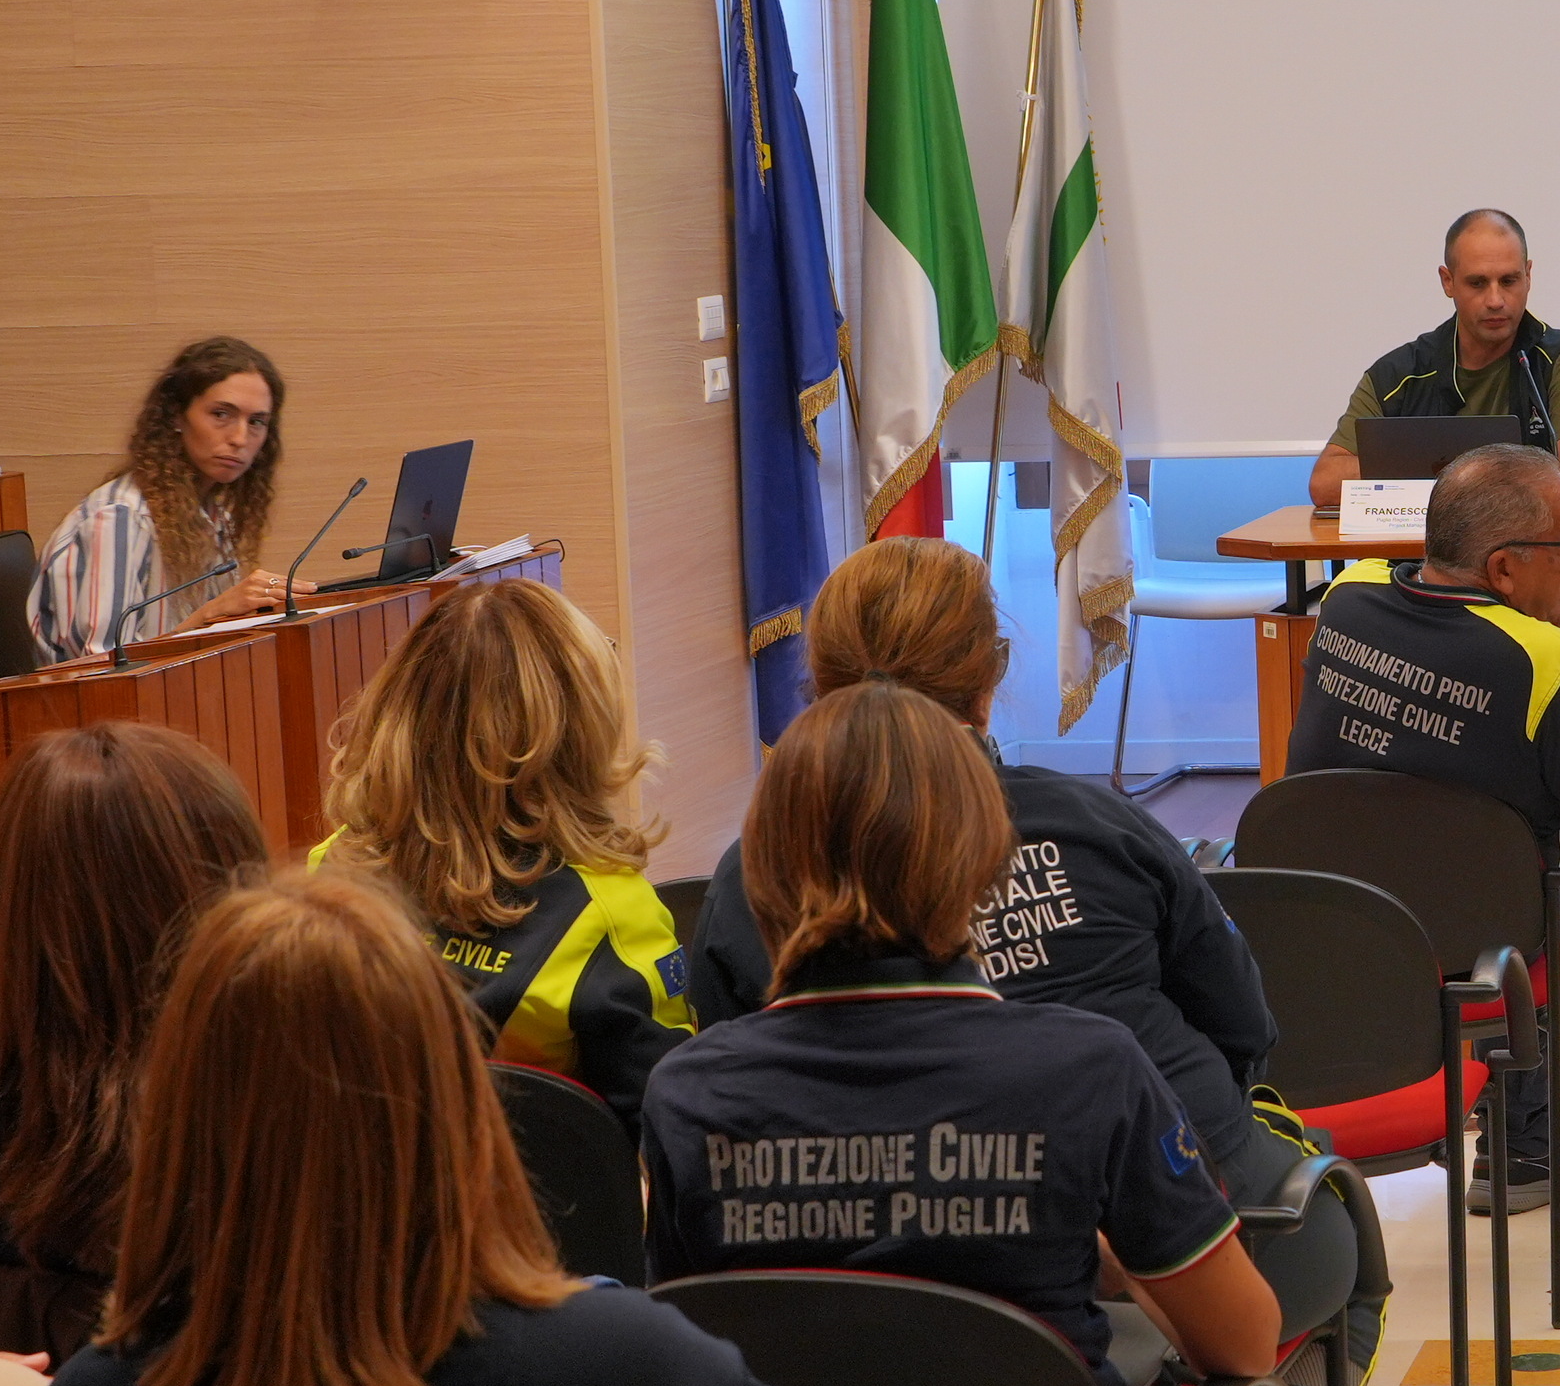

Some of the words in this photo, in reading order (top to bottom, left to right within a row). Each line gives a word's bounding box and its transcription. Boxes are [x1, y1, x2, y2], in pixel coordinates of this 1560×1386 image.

[1365, 507, 1429, 516] FRANCESCO
[1316, 625, 1436, 696] COORDINAMENTO
[1436, 676, 1493, 716] PROV.
[1317, 664, 1401, 721] PROTEZIONE
[1402, 703, 1465, 746] CIVILE
[1339, 715, 1394, 756] LECCE
[1002, 898, 1083, 942] CIVILE
[442, 937, 512, 973] CIVILE
